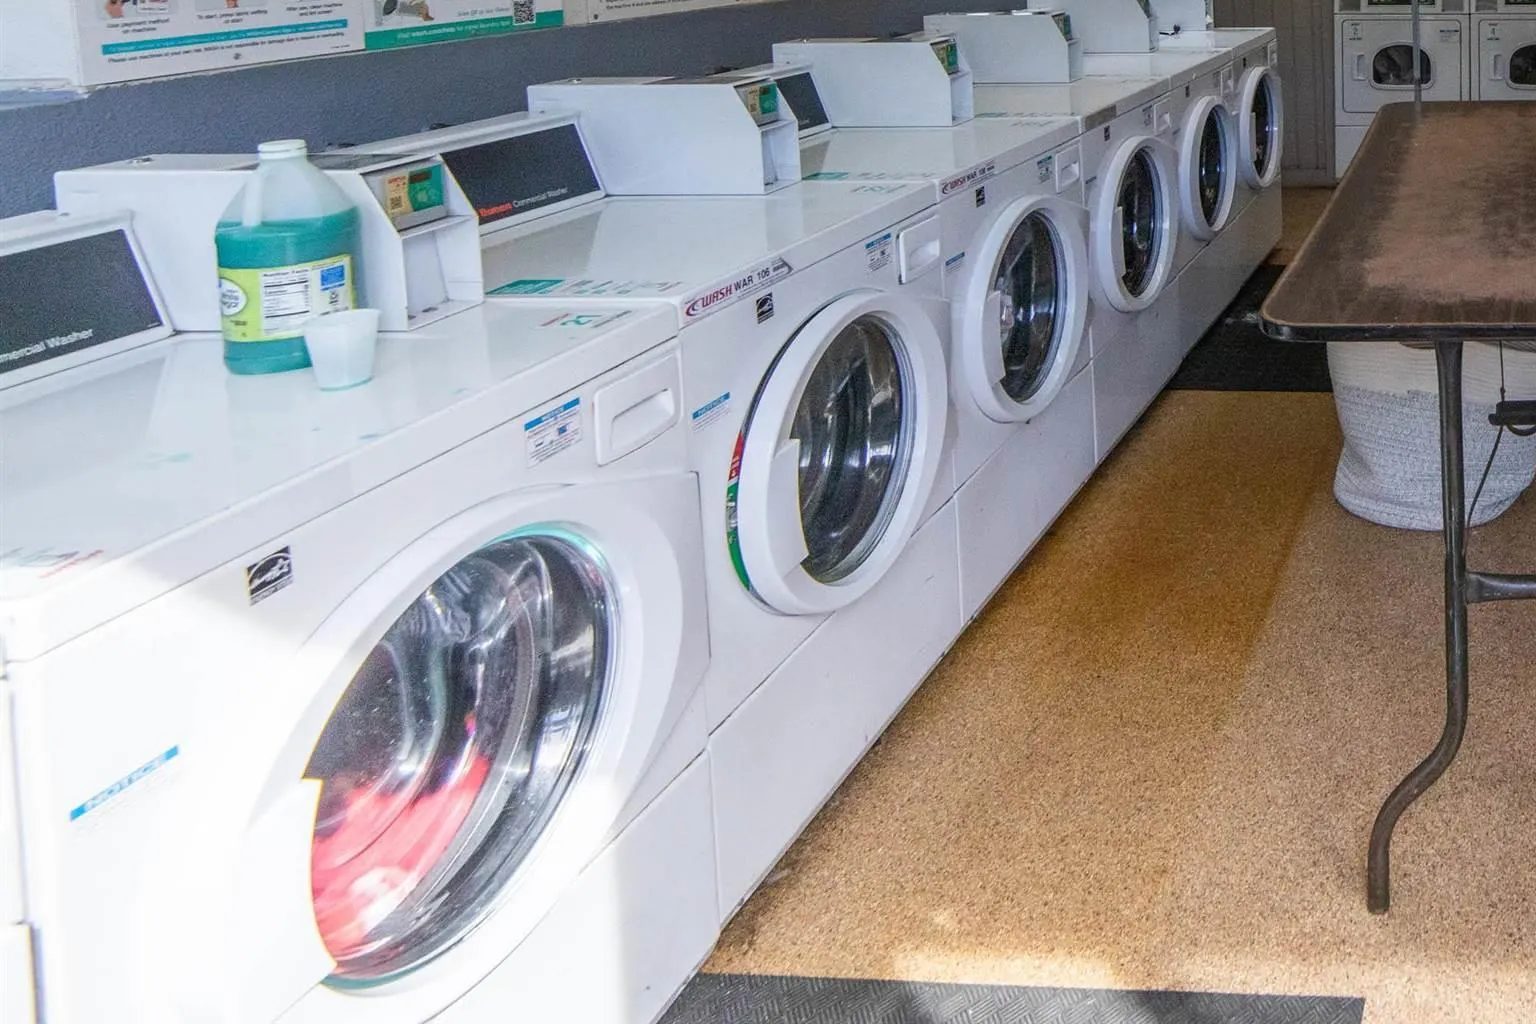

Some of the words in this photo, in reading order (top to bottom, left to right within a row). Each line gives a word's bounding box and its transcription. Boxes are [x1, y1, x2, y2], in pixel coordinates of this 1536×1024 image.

[701, 283, 733, 308] WASH
[734, 275, 754, 292] WAR
[757, 267, 770, 281] 106
[46, 328, 93, 349] Washer
